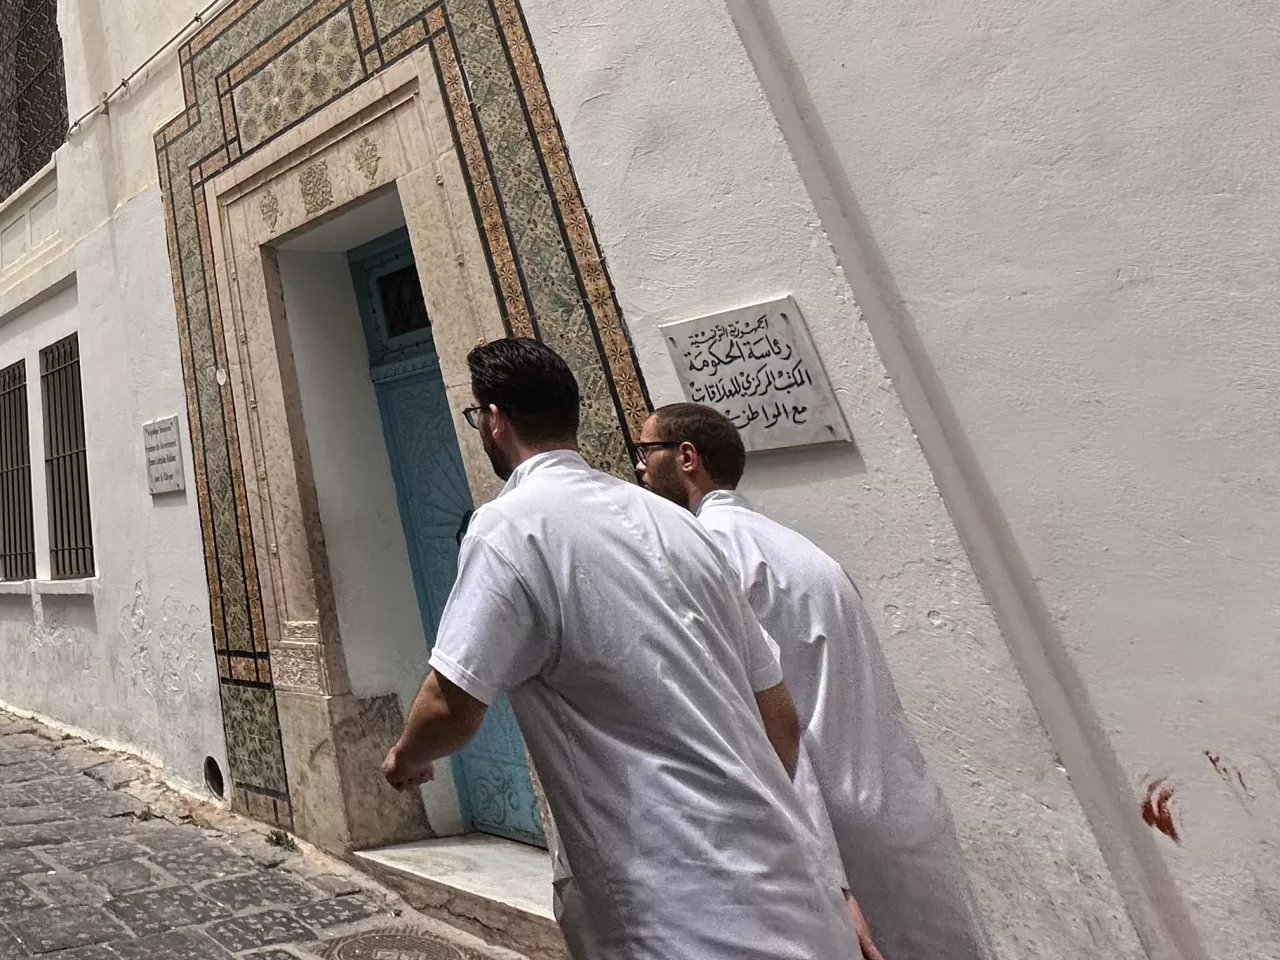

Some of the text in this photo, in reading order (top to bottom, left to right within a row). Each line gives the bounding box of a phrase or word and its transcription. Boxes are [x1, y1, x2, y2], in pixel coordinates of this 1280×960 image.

[688, 314, 769, 348] الجمهورية التونسية
[684, 334, 792, 376] رئاسة الحكومة
[689, 359, 812, 403] المكتب المركزي للعلاقات
[792, 405, 808, 425] مع
